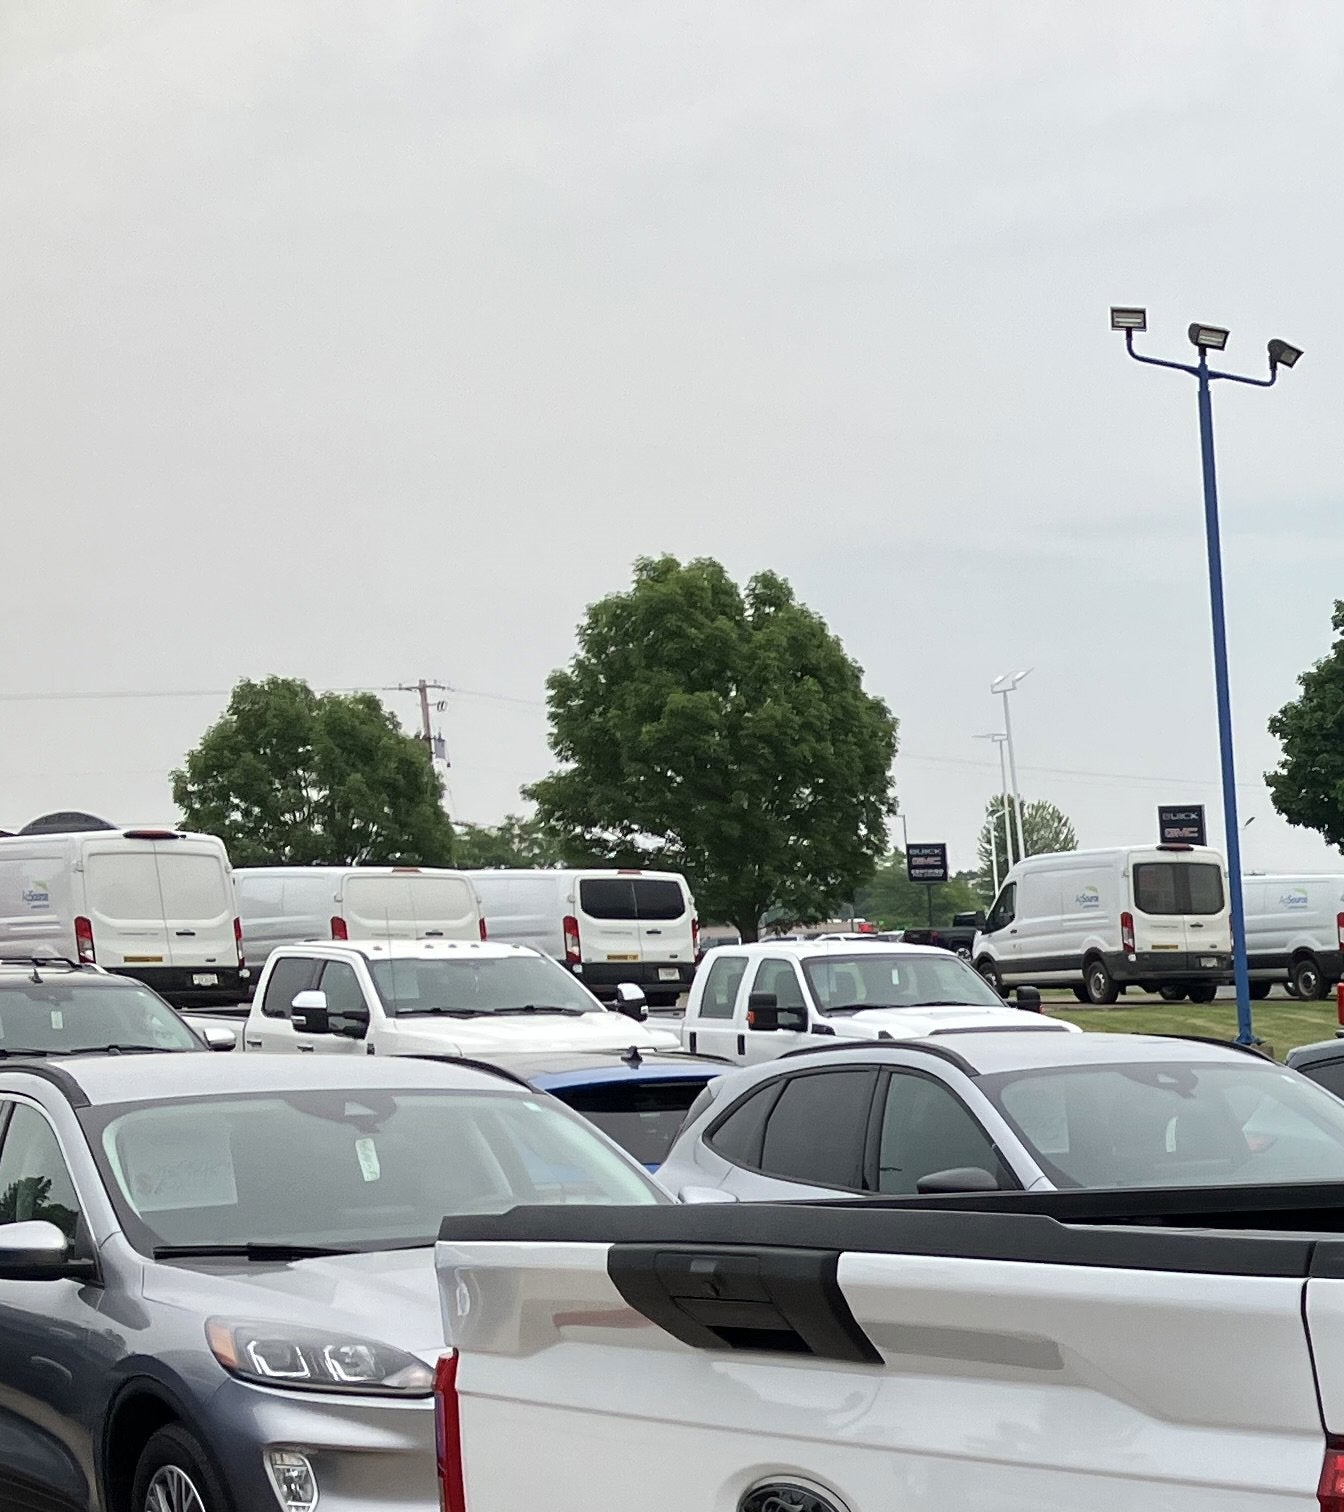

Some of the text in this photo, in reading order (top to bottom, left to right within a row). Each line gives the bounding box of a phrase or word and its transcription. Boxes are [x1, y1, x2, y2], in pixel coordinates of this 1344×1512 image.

[1162, 812, 1199, 820] BUICK
[1165, 827, 1198, 838] GMC
[911, 856, 942, 865] GMC
